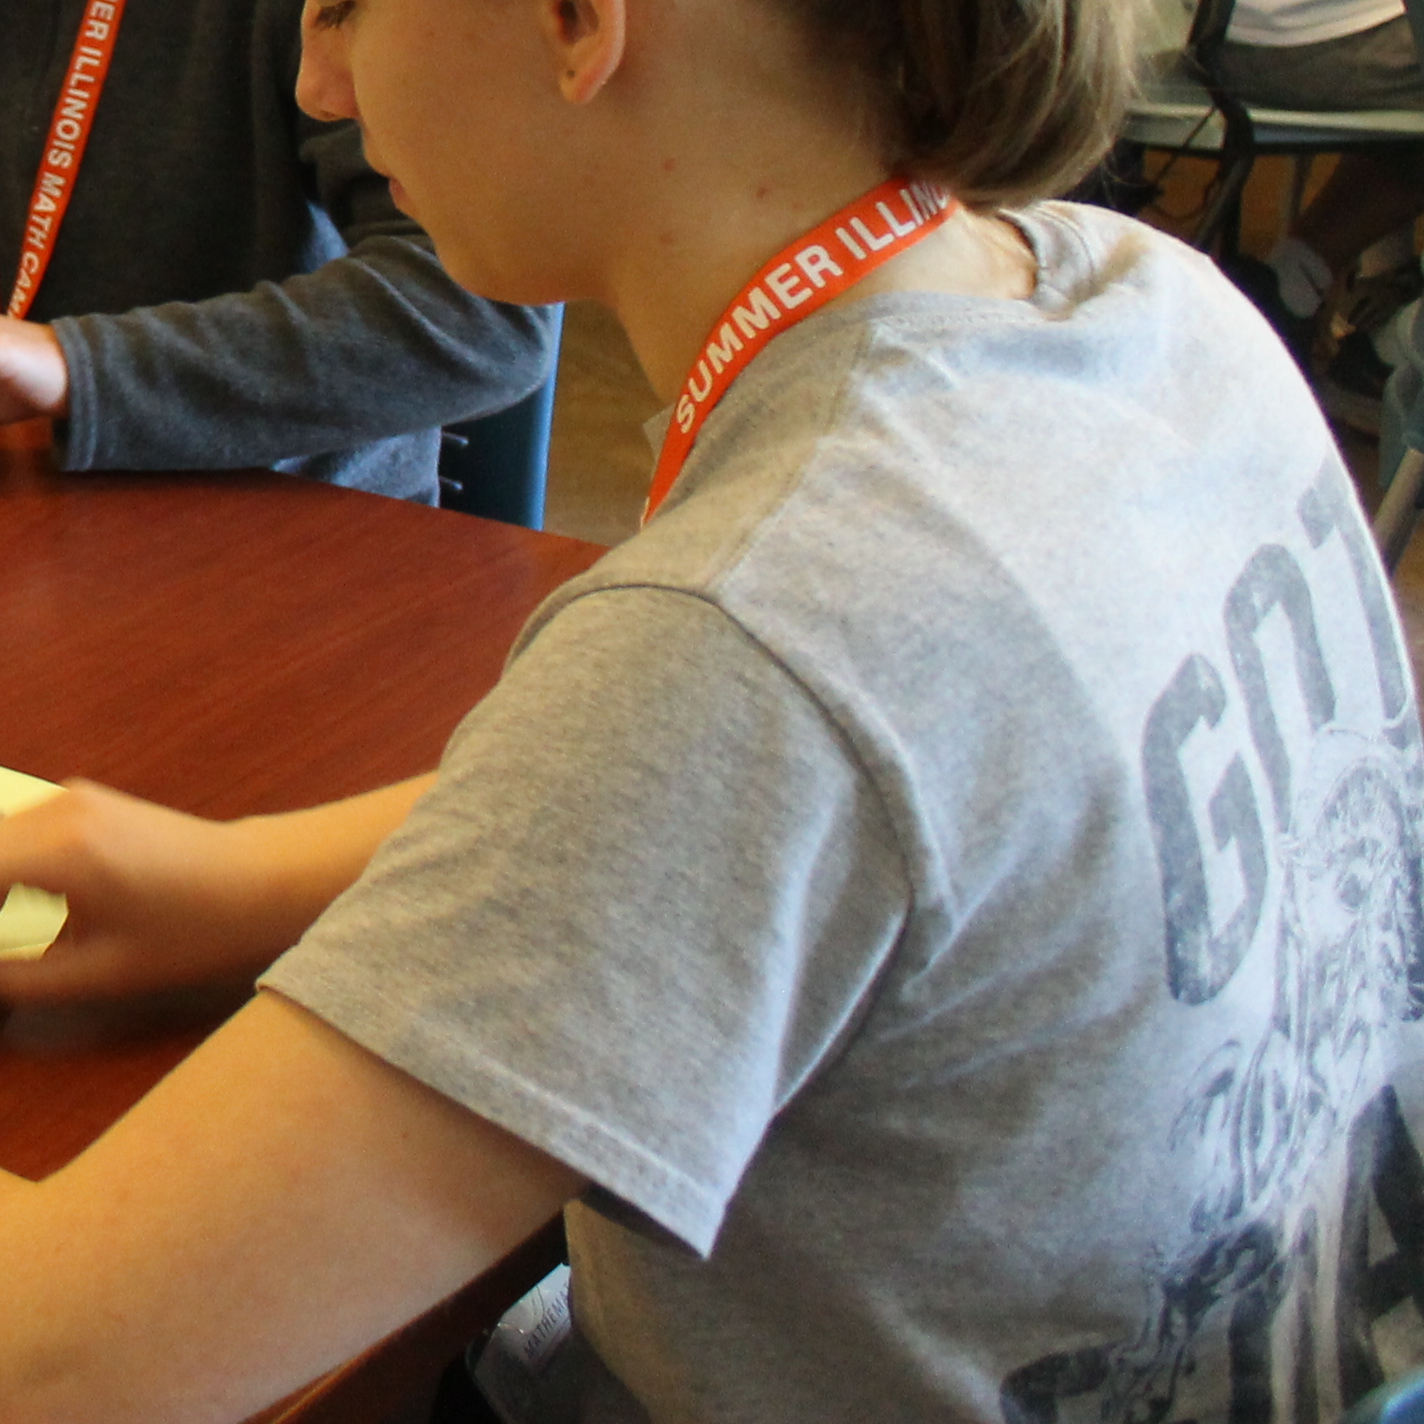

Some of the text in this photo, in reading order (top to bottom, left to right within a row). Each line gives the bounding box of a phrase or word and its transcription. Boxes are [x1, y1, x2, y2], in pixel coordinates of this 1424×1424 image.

[47, 44, 104, 169] ILLINOIS
[27, 171, 67, 250] MATH
[674, 244, 845, 435] SUMMER
